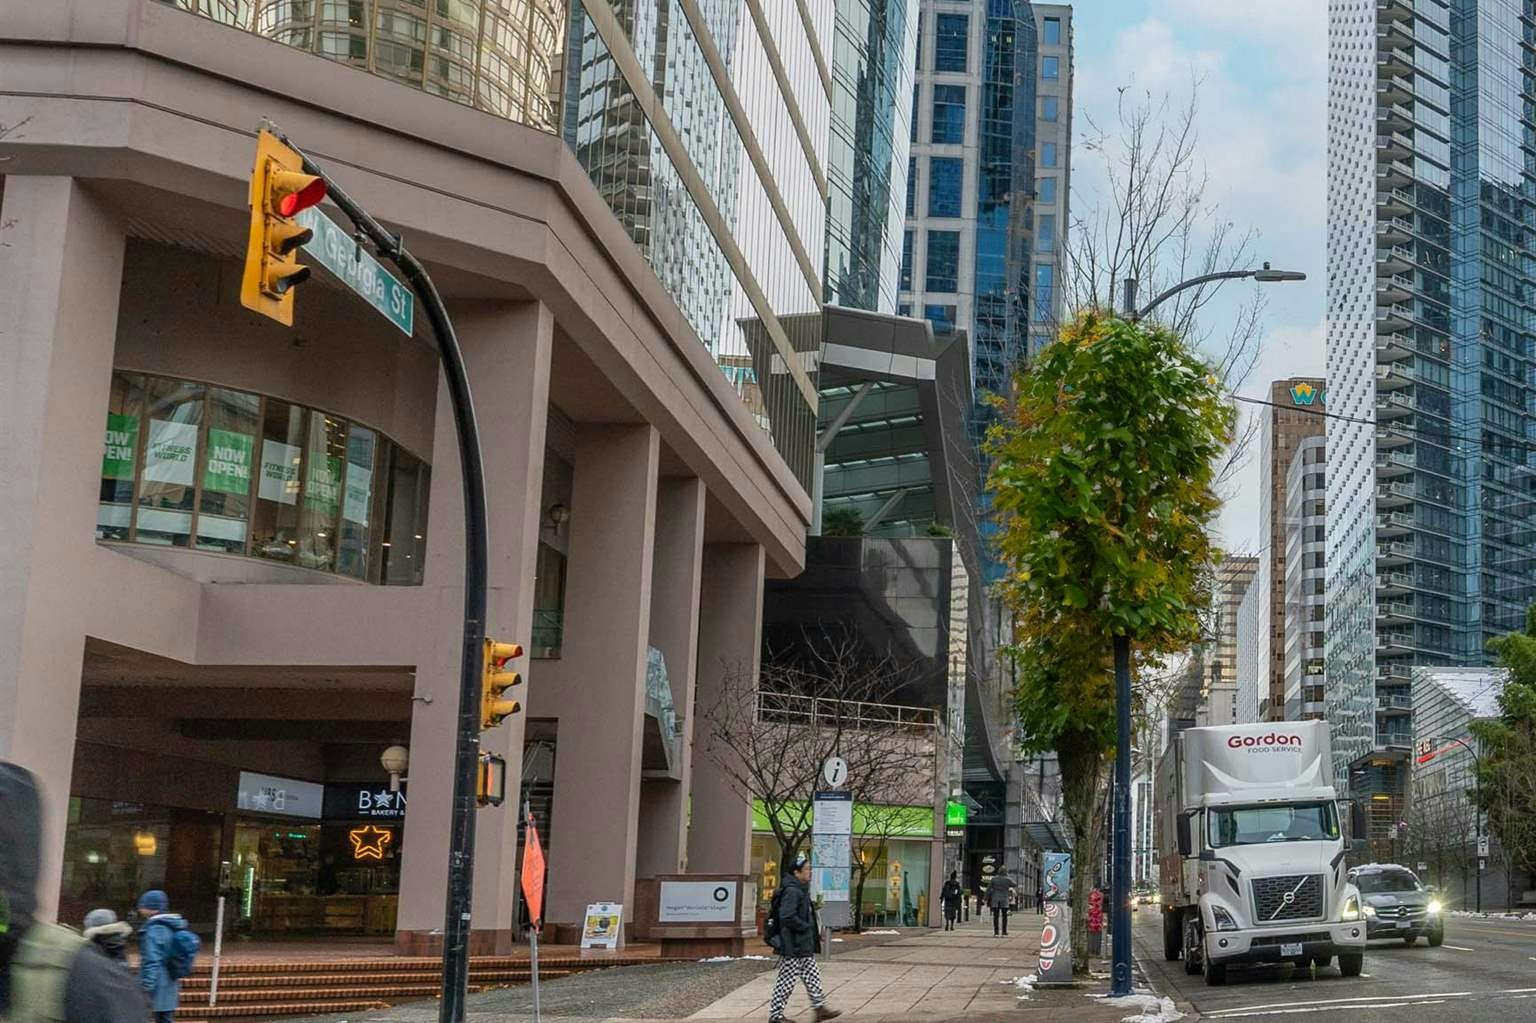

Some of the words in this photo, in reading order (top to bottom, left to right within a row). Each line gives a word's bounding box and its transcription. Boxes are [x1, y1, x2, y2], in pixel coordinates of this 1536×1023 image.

[325, 227, 385, 302] Georgia
[391, 284, 407, 319] St
[104, 430, 129, 446] OW
[104, 446, 132, 461] EN!
[153, 451, 189, 463] WORLD
[213, 445, 246, 464] NOW
[208, 459, 248, 479] OPEN!
[1228, 732, 1302, 748] Gordon
